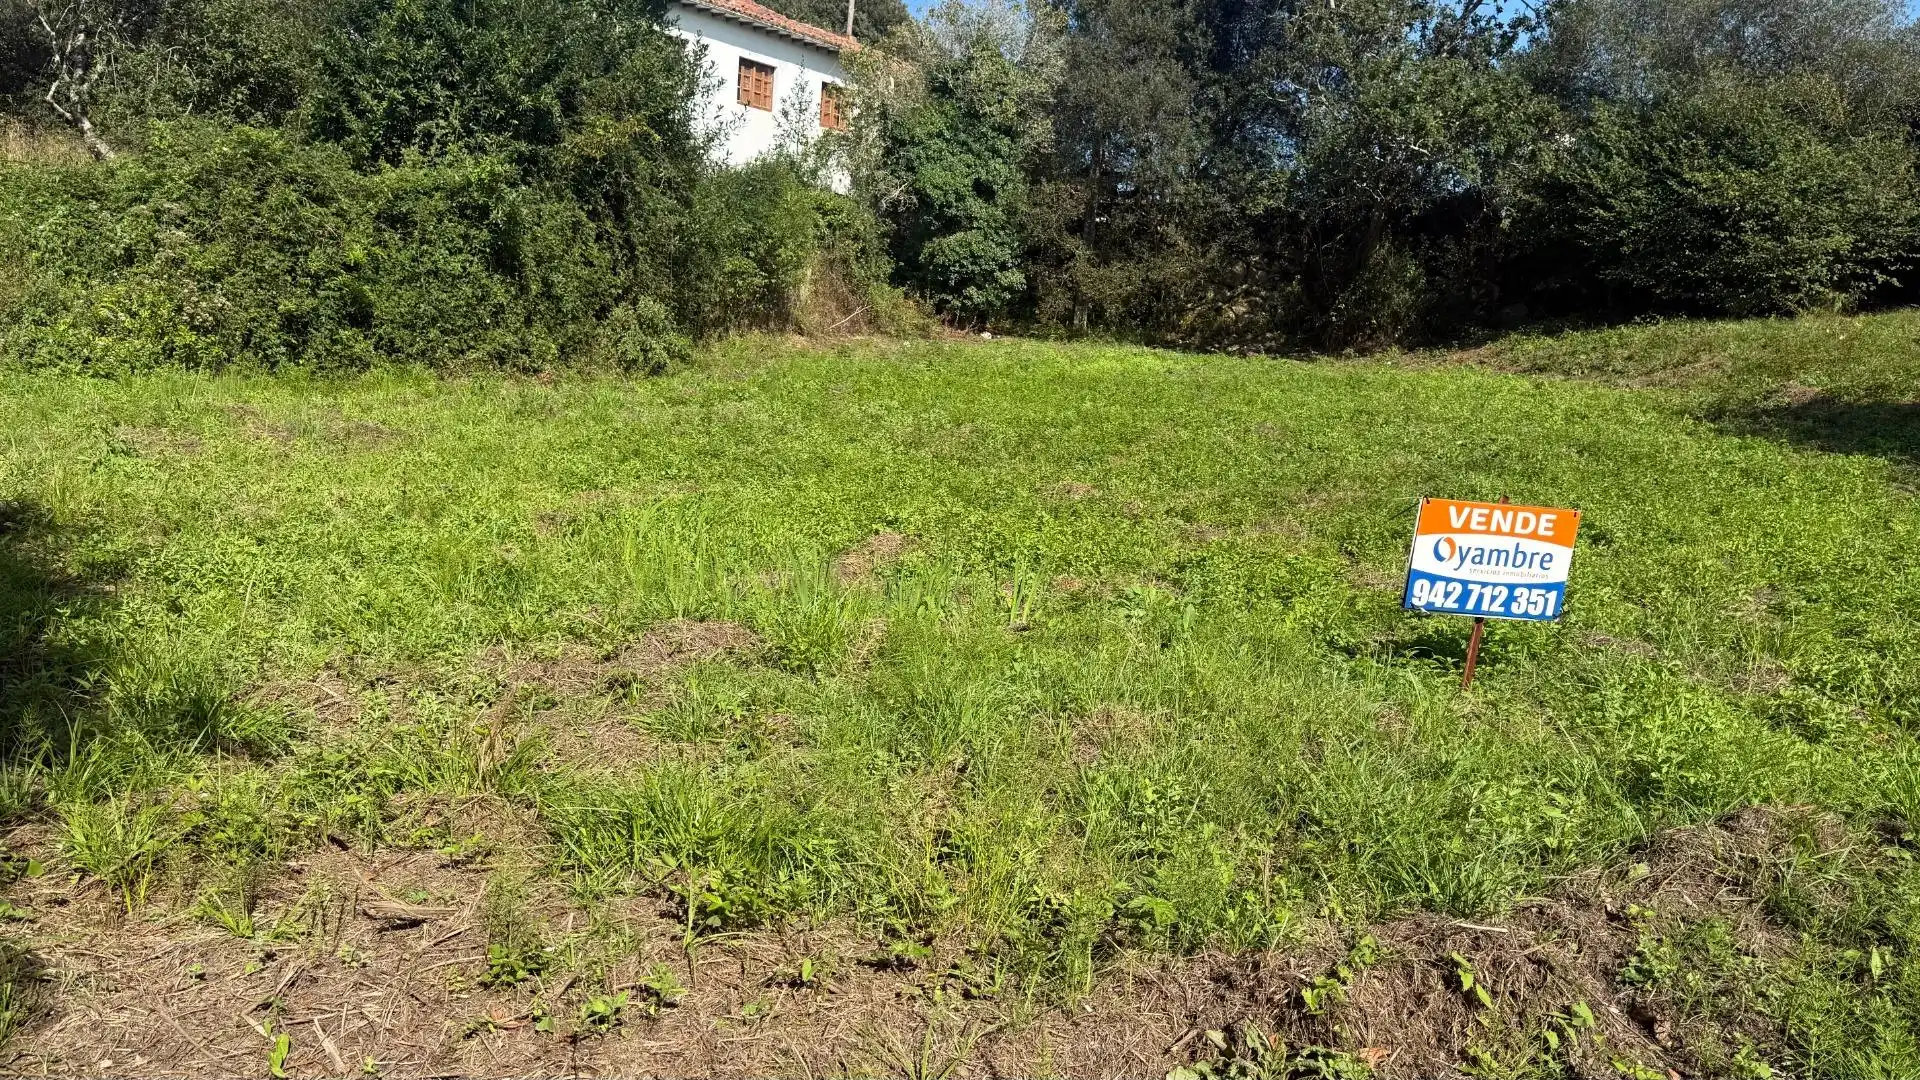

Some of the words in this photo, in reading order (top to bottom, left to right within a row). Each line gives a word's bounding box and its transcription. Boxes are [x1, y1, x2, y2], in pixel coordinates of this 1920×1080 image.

[1448, 505, 1557, 537] VENDE
[1433, 536, 1554, 571] Oyambre
[1411, 578, 1463, 609] 942
[1465, 583, 1509, 613] 712
[1511, 587, 1558, 617] 351
